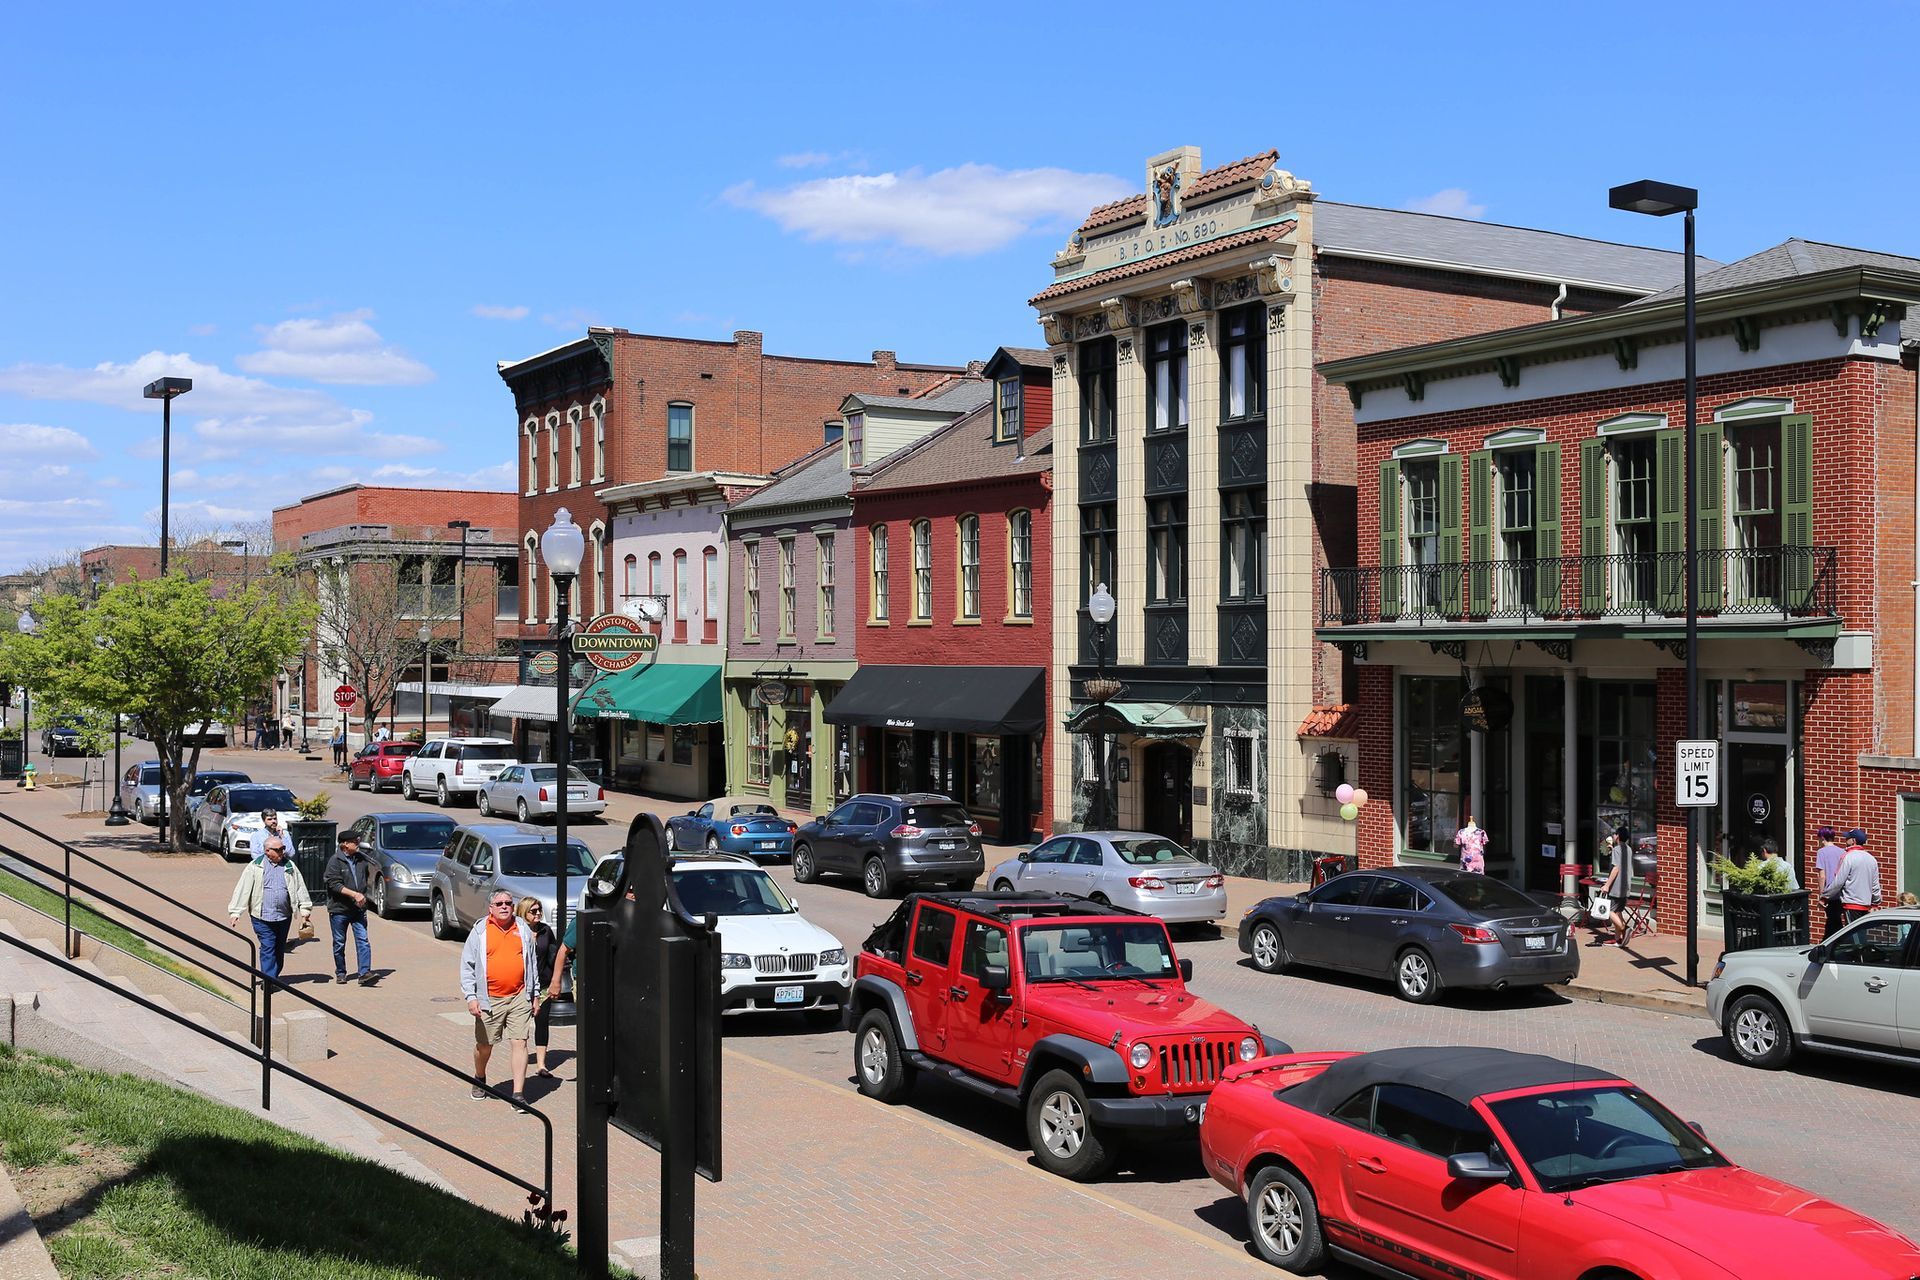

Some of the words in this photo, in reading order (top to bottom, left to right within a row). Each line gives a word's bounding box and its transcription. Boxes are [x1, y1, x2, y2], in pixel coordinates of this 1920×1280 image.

[596, 617, 635, 630] HISTORIC
[578, 637, 653, 648] DOWNTOWN
[603, 654, 638, 669] CHARLES
[335, 692, 355, 701] STOP
[1680, 748, 1714, 759] SPEED
[1684, 761, 1710, 771] LIMIT
[1685, 775, 1709, 798] 15
